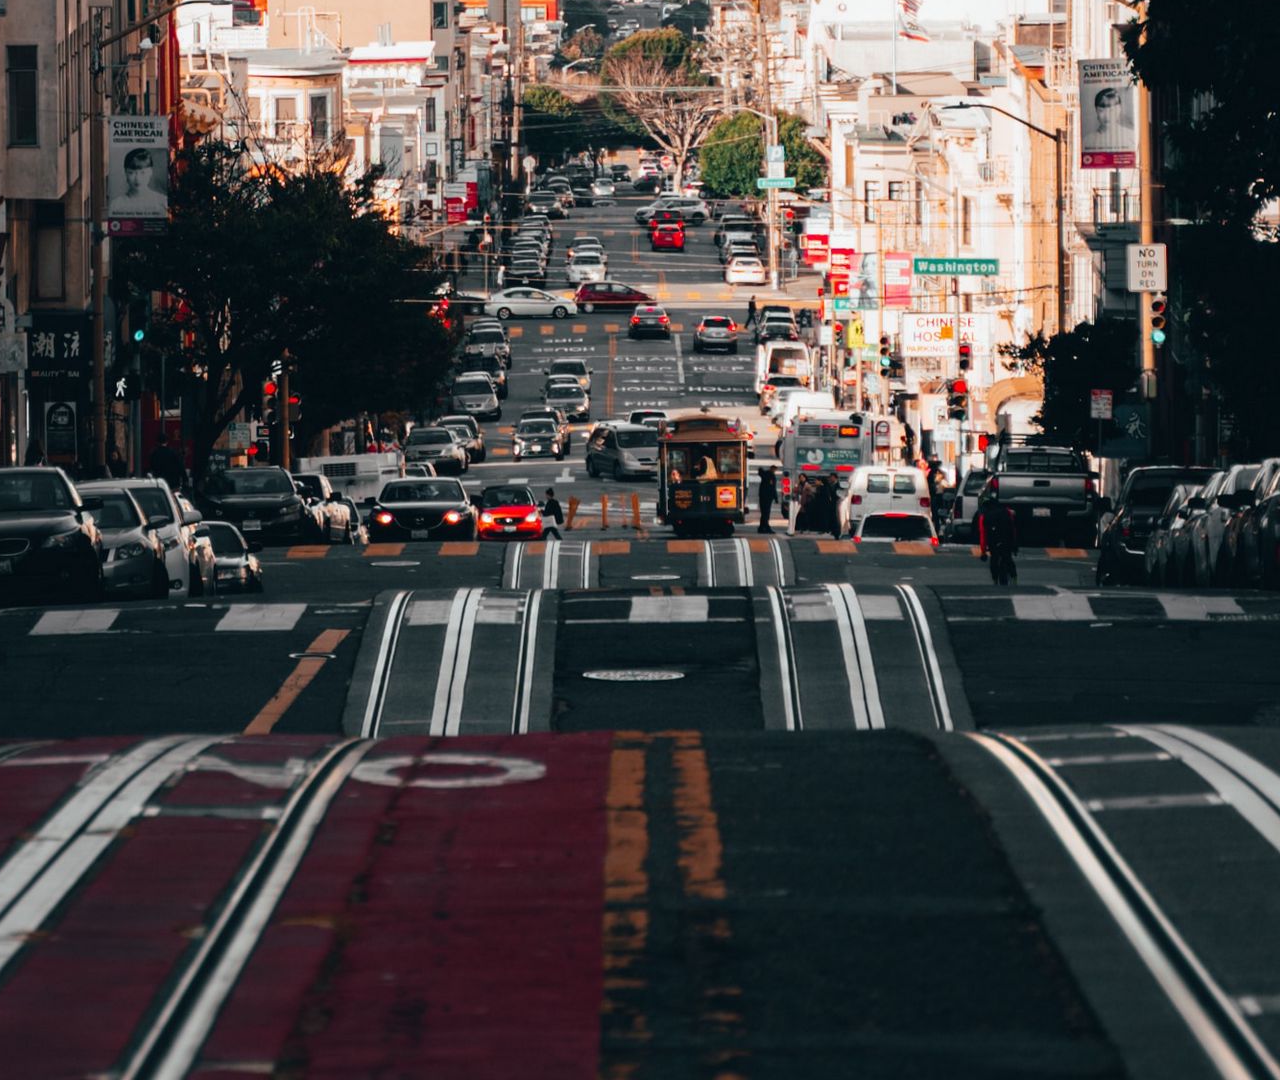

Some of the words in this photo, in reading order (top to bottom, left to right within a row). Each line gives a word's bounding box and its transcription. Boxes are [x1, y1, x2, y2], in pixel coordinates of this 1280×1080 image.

[113, 121, 155, 129] CHINESE
[113, 129, 163, 137] AMERICAN
[1138, 249, 1156, 258] NO
[917, 261, 996, 274] Washington
[1137, 260, 1158, 268] TURN
[1141, 270, 1154, 278] ON
[1139, 280, 1156, 288] RED
[913, 331, 977, 342] HOSAL
